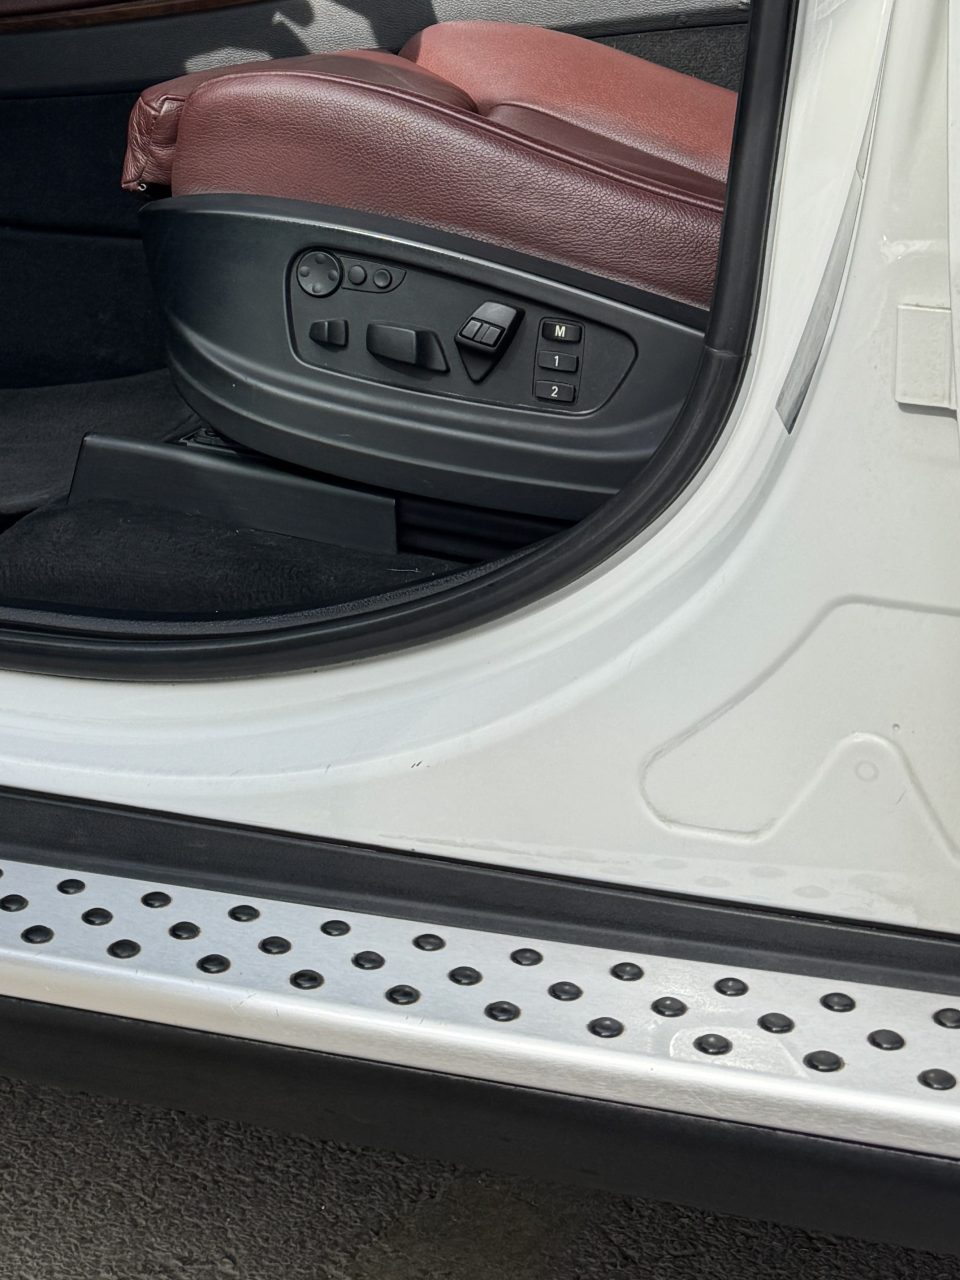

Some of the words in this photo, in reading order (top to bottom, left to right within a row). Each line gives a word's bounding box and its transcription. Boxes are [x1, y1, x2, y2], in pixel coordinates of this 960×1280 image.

[554, 324, 566, 338] M
[553, 355, 559, 367] 1
[550, 385, 559, 398] 2
